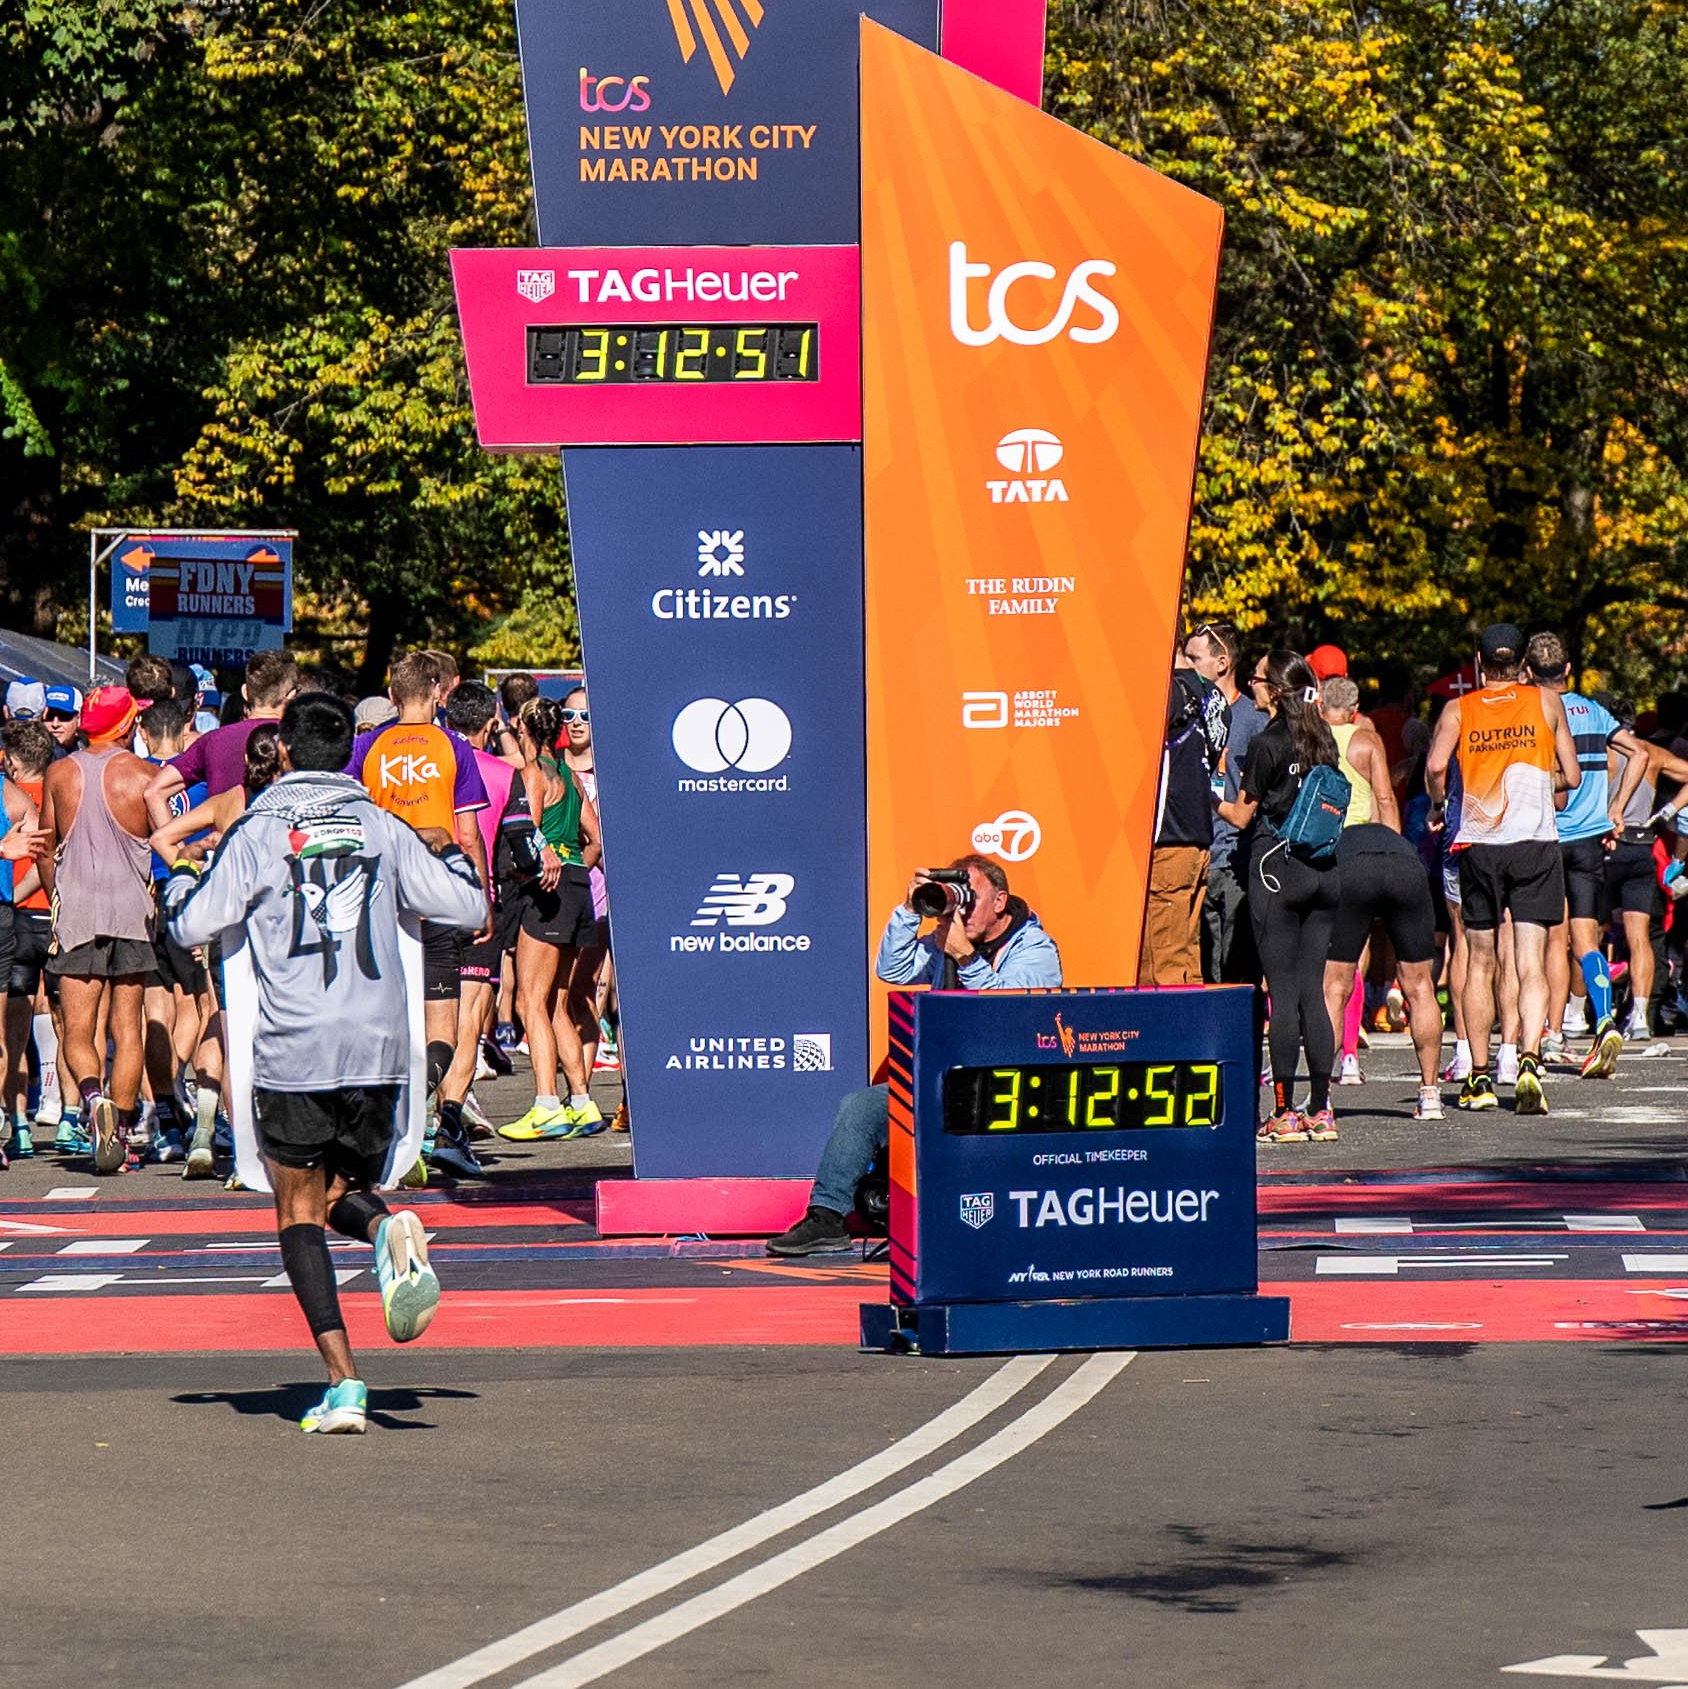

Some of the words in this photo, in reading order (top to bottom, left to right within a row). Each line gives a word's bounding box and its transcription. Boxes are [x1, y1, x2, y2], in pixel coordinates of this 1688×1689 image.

[578, 66, 651, 112] tcs
[579, 125, 652, 149] NEW
[659, 125, 744, 149] YORK
[749, 124, 817, 149] CITY
[579, 156, 758, 182] MARATHON
[520, 272, 552, 284] TAG
[518, 283, 555, 300] HEUER
[948, 240, 1120, 347] tcs
[985, 478, 1069, 503] TATA
[178, 561, 257, 595] FDNY
[965, 578, 1007, 594] THE
[1011, 577, 1076, 594] RUDIN
[177, 594, 256, 615] RUNNERS
[651, 588, 793, 619] Citizens
[988, 598, 1059, 615] FAMILY
[174, 620, 263, 646] NYPD
[1014, 690, 1058, 700] ABBOTT
[1014, 699, 1054, 708] WORLD
[1014, 708, 1080, 717] MARATHON
[1014, 717, 1061, 727] MAJORS
[1468, 724, 1536, 744] OUTRUN
[1468, 738, 1538, 754] PARKINSON'S
[678, 775, 791, 793] mastercard
[973, 831, 1001, 844] abc
[670, 935, 716, 952] new
[719, 931, 811, 952] balance
[690, 1037, 785, 1052] UNITED
[1078, 1033, 1099, 1043] NEW
[1099, 1032, 1121, 1042] YORK
[1121, 1030, 1140, 1040] CITY
[1078, 1041, 1126, 1053] MARATHON
[665, 1054, 786, 1070] AIRLINES
[1032, 1152, 1083, 1166] OFFICIAL
[1085, 1149, 1148, 1164] TIMEKEEPER
[962, 1196, 991, 1208] TAG
[960, 1207, 993, 1224] HEUER
[1052, 1271, 1075, 1280] NEW
[1076, 1270, 1102, 1280] YORK
[1103, 1268, 1129, 1279] ROAD
[1130, 1266, 1174, 1278] RUNNERS
